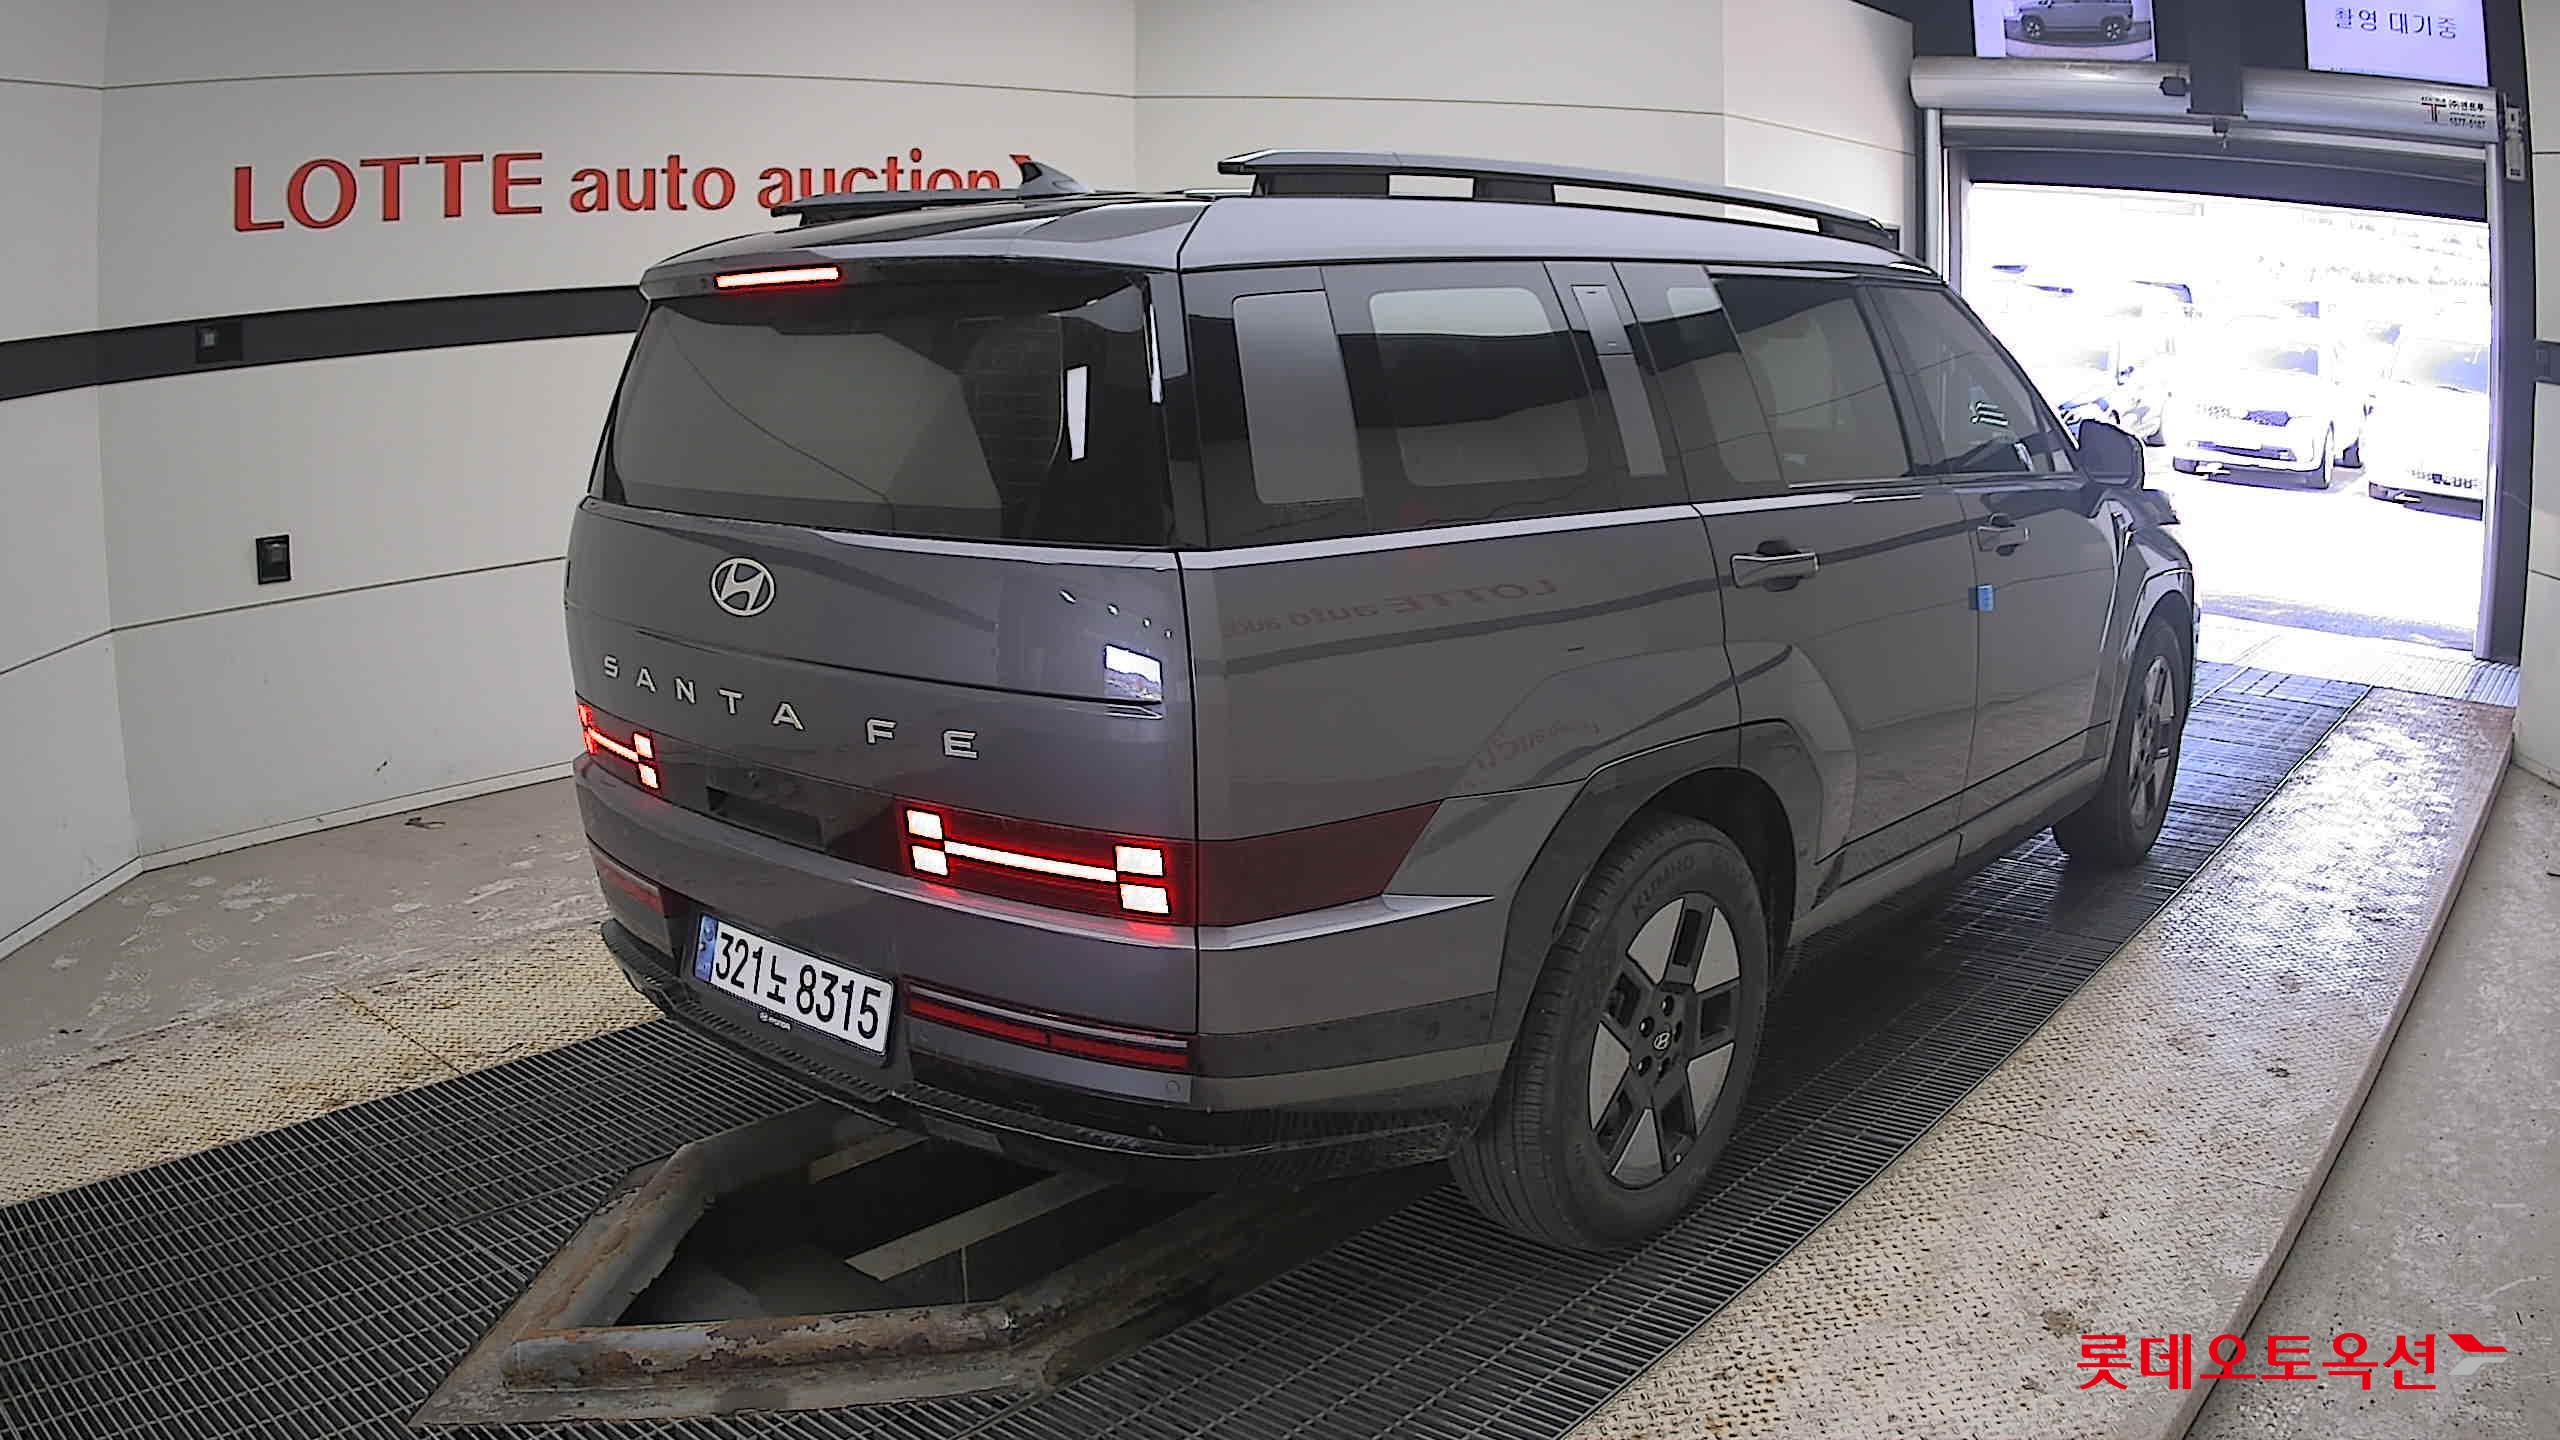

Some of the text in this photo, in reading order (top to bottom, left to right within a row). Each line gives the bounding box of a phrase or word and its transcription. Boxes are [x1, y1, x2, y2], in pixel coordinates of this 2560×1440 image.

[234, 152, 543, 233] LOTTE
[570, 154, 736, 212] auto
[603, 654, 979, 760] SANTA FE
[715, 931, 883, 1040] 321노 8315
